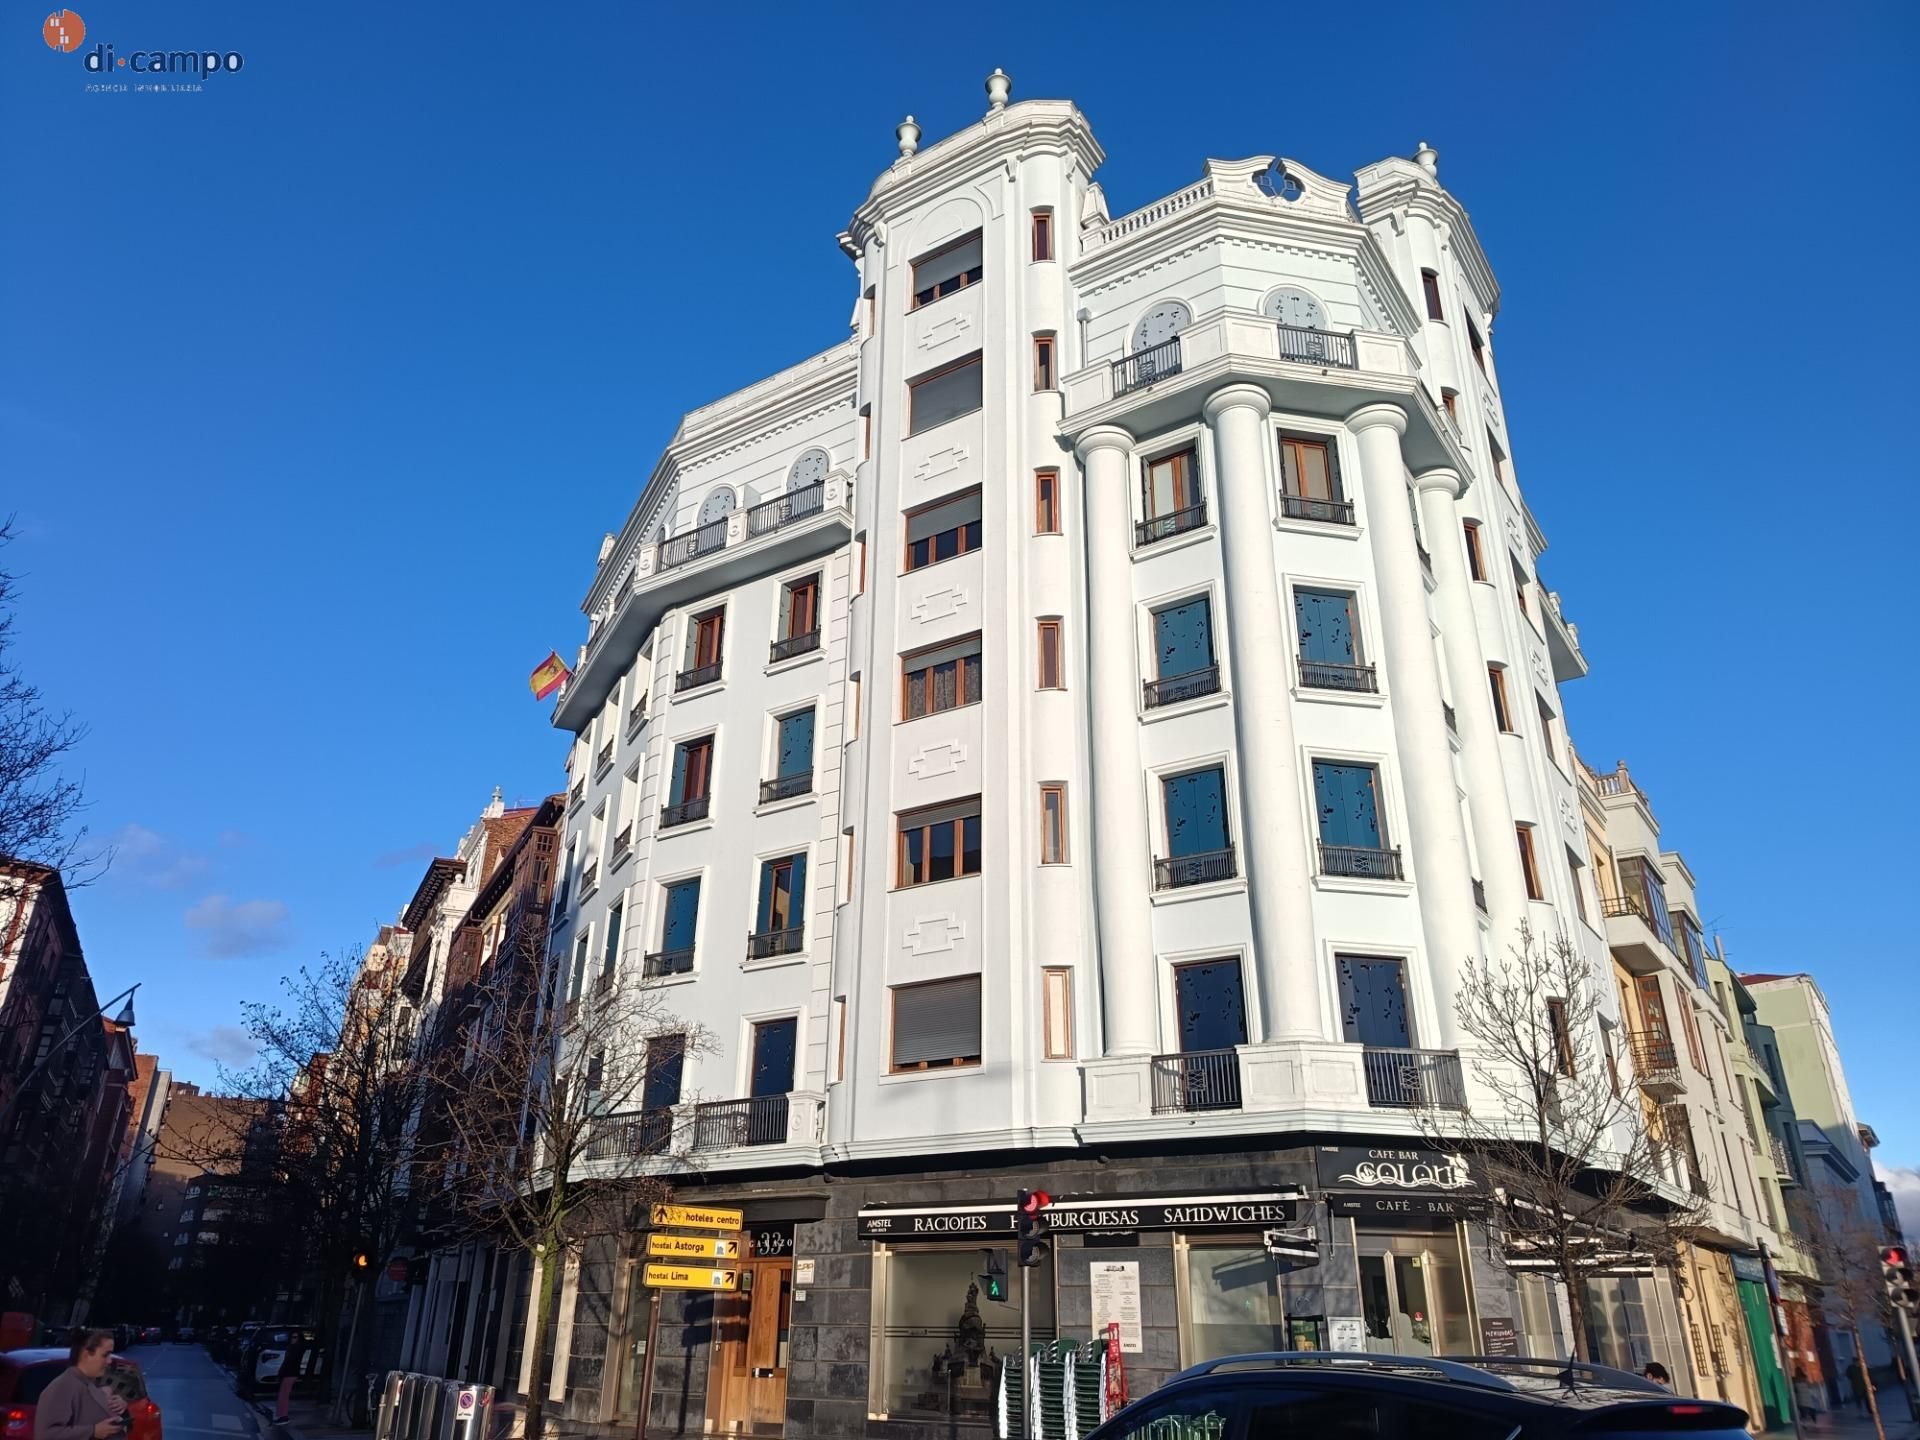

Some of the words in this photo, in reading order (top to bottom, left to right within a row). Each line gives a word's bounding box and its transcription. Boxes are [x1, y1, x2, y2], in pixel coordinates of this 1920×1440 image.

[1399, 1151, 1419, 1160] BAR
[1375, 1200, 1411, 1211] CAFÉ
[1428, 1202, 1454, 1212] BAR
[685, 1213, 714, 1223] hoteles
[716, 1216, 740, 1225] centro
[1163, 1205, 1286, 1224] SANDWICHES
[867, 1219, 892, 1228] AMSTEL
[914, 1215, 987, 1232] RACIONES
[651, 1242, 672, 1250] hostal
[674, 1241, 705, 1253] Astorga
[759, 1231, 782, 1255] 33
[648, 1272, 669, 1280] hostal
[670, 1271, 689, 1281] Lima
